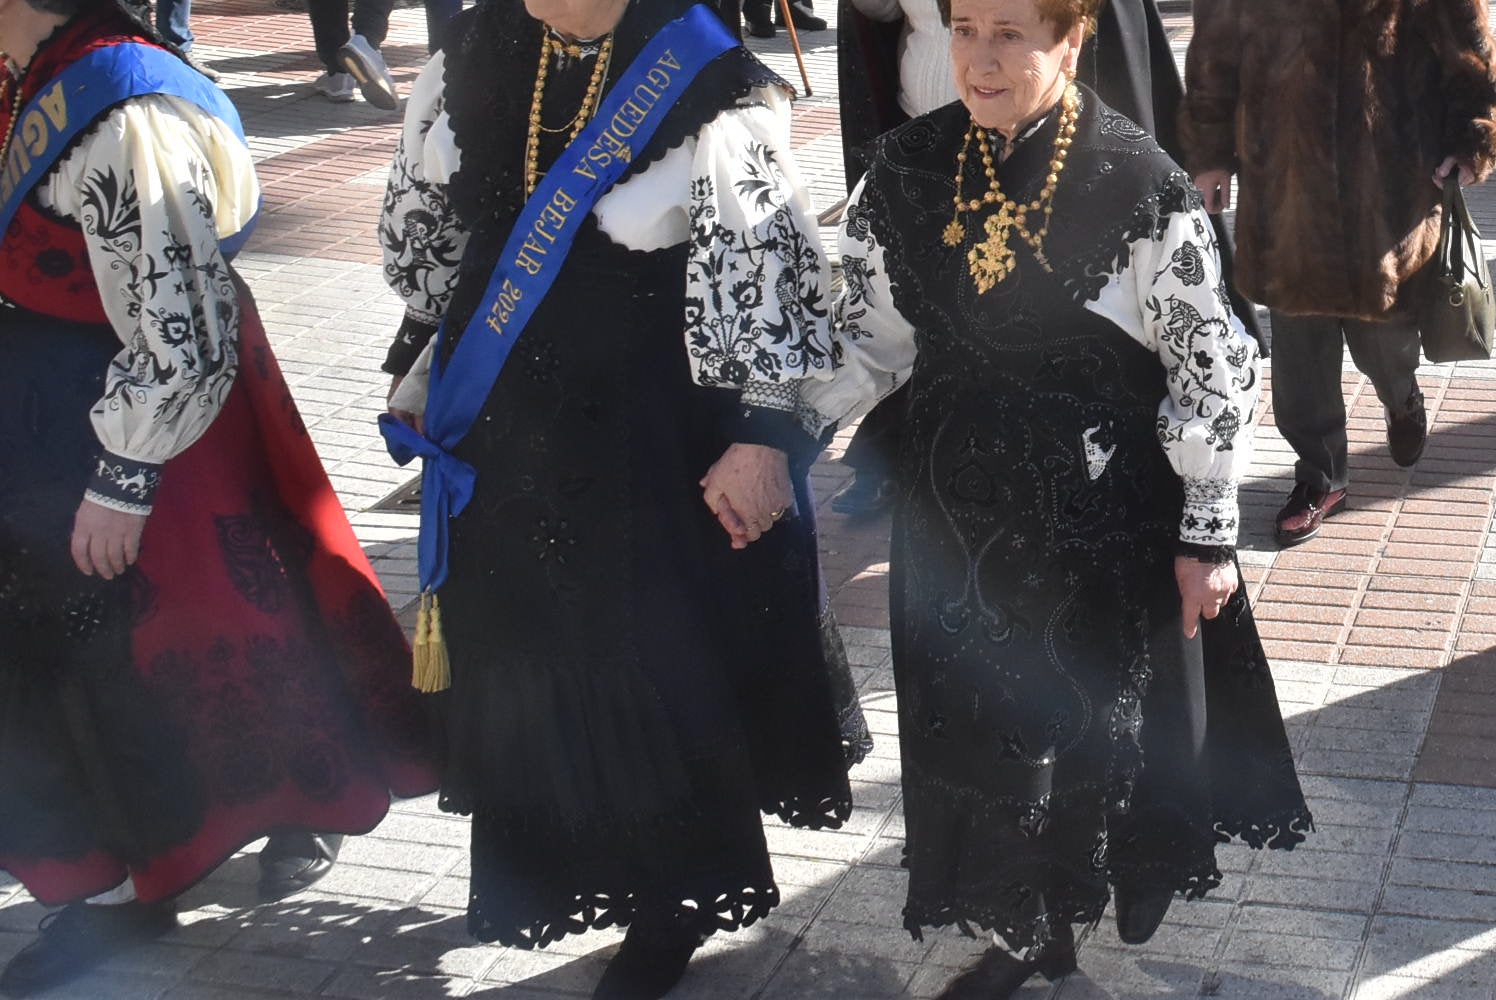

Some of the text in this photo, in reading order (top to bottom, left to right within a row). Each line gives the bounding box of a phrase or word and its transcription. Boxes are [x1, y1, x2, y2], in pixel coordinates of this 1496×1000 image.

[485, 49, 682, 336] AGUEDESA BEJAR 2024
